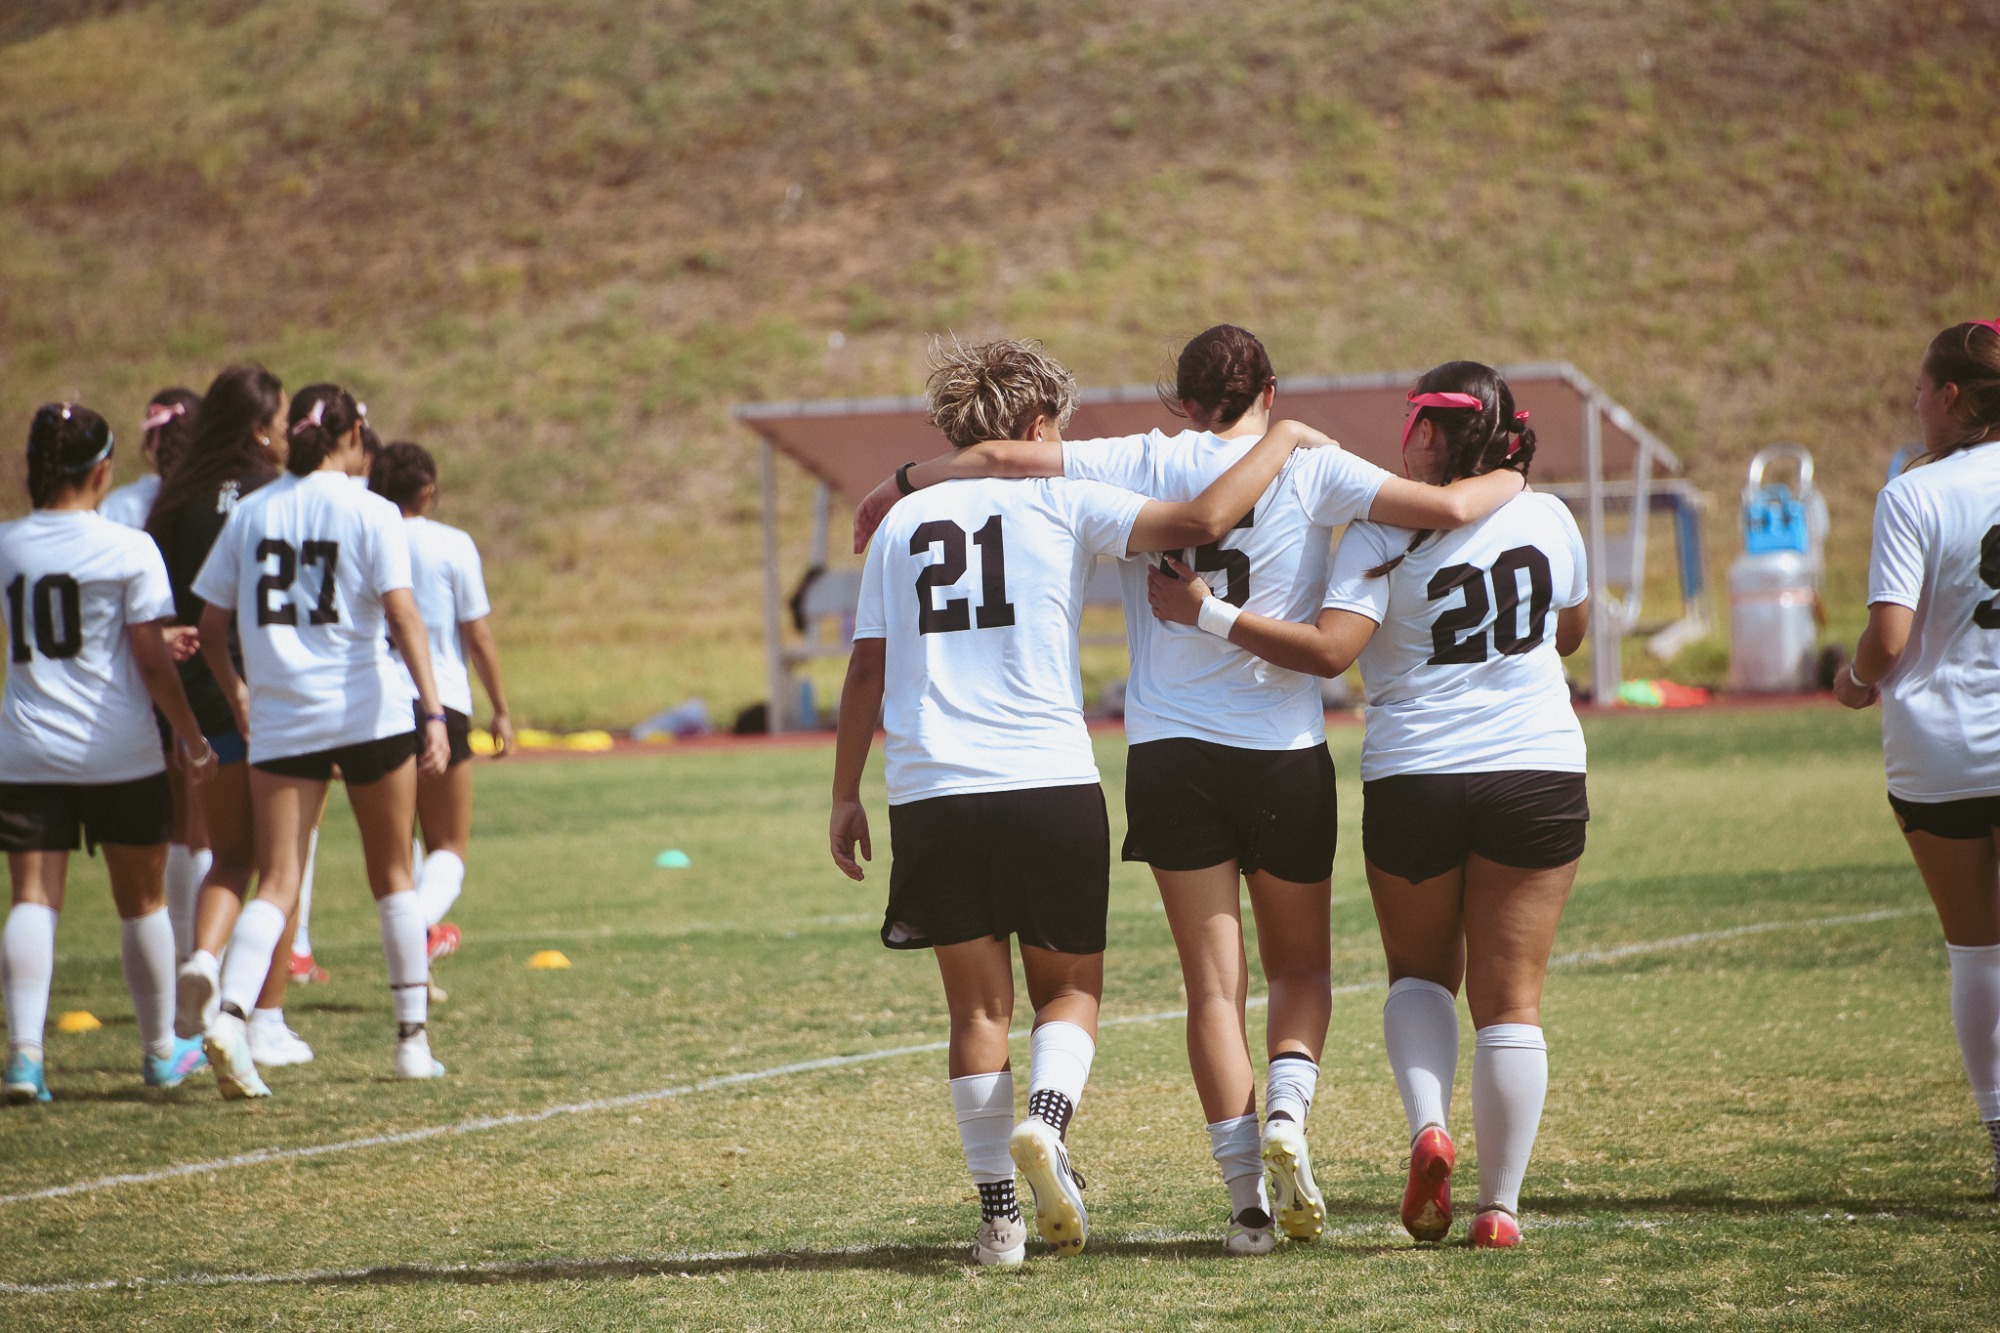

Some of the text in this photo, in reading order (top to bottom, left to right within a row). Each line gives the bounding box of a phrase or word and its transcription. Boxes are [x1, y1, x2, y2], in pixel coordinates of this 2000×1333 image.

[256, 538, 339, 627] 27
[909, 514, 1015, 636] 21
[1160, 506, 1255, 609] 5
[1426, 545, 1552, 667] 20
[6, 573, 83, 664] 10
